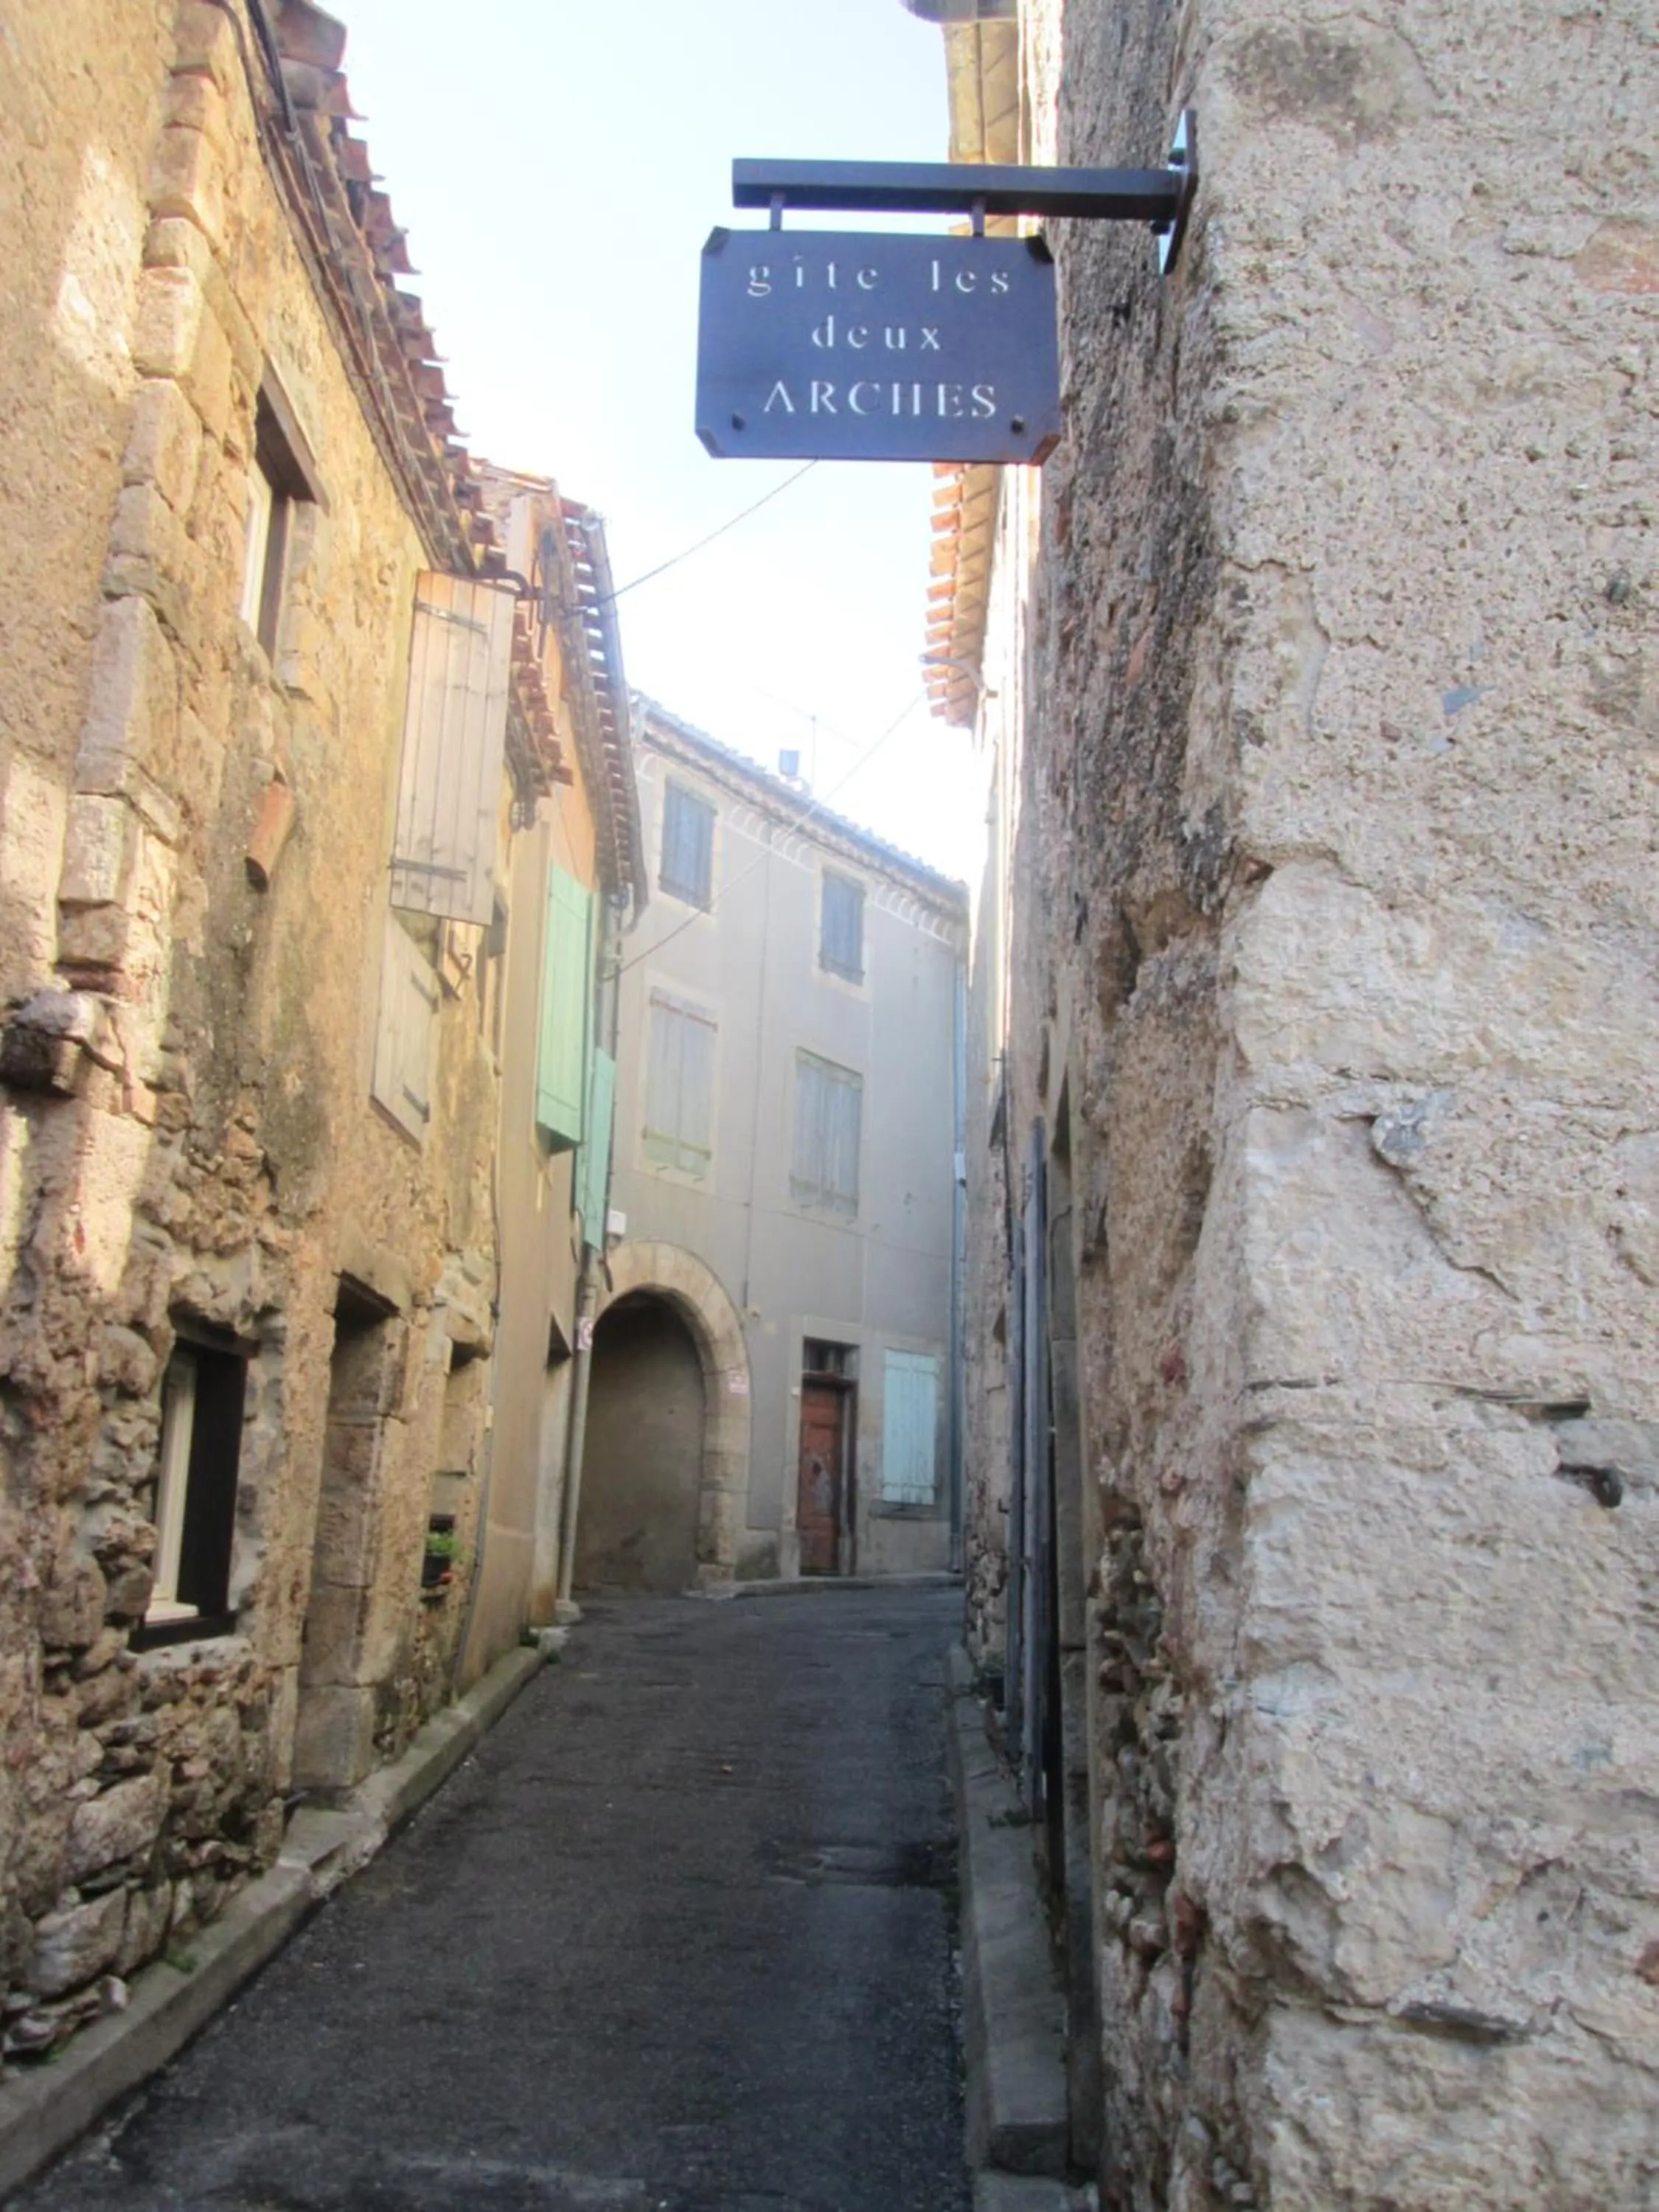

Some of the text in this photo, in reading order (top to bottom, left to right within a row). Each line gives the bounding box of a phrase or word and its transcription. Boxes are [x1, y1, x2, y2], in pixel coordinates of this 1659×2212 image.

[931, 259, 1009, 293] les
[810, 314, 940, 350] deux
[762, 379, 997, 418] ARCHES
